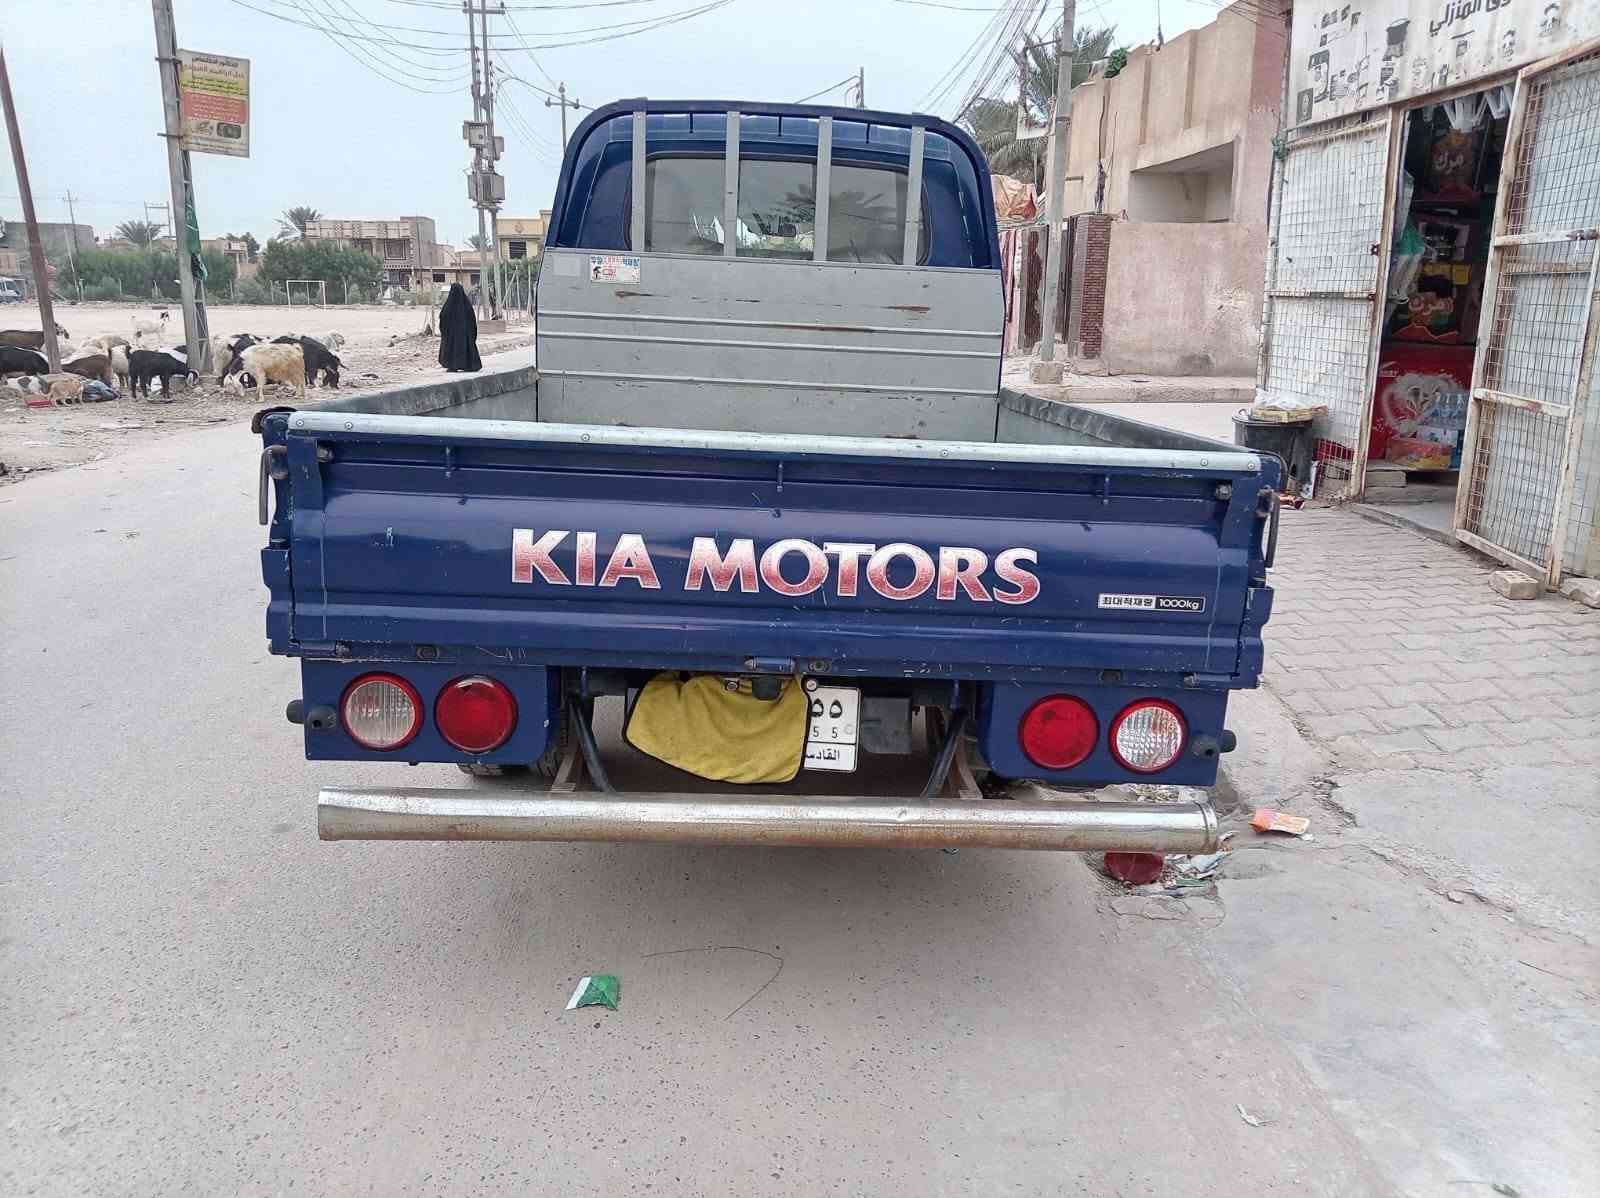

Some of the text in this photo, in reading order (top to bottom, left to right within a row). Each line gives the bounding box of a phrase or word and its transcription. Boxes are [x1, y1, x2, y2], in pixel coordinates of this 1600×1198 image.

[1429, 0, 1483, 37] المنزلي
[511, 528, 1042, 604] KIA MOTORS
[1159, 598, 1200, 610] 1000kg
[806, 748, 840, 761] القادس
